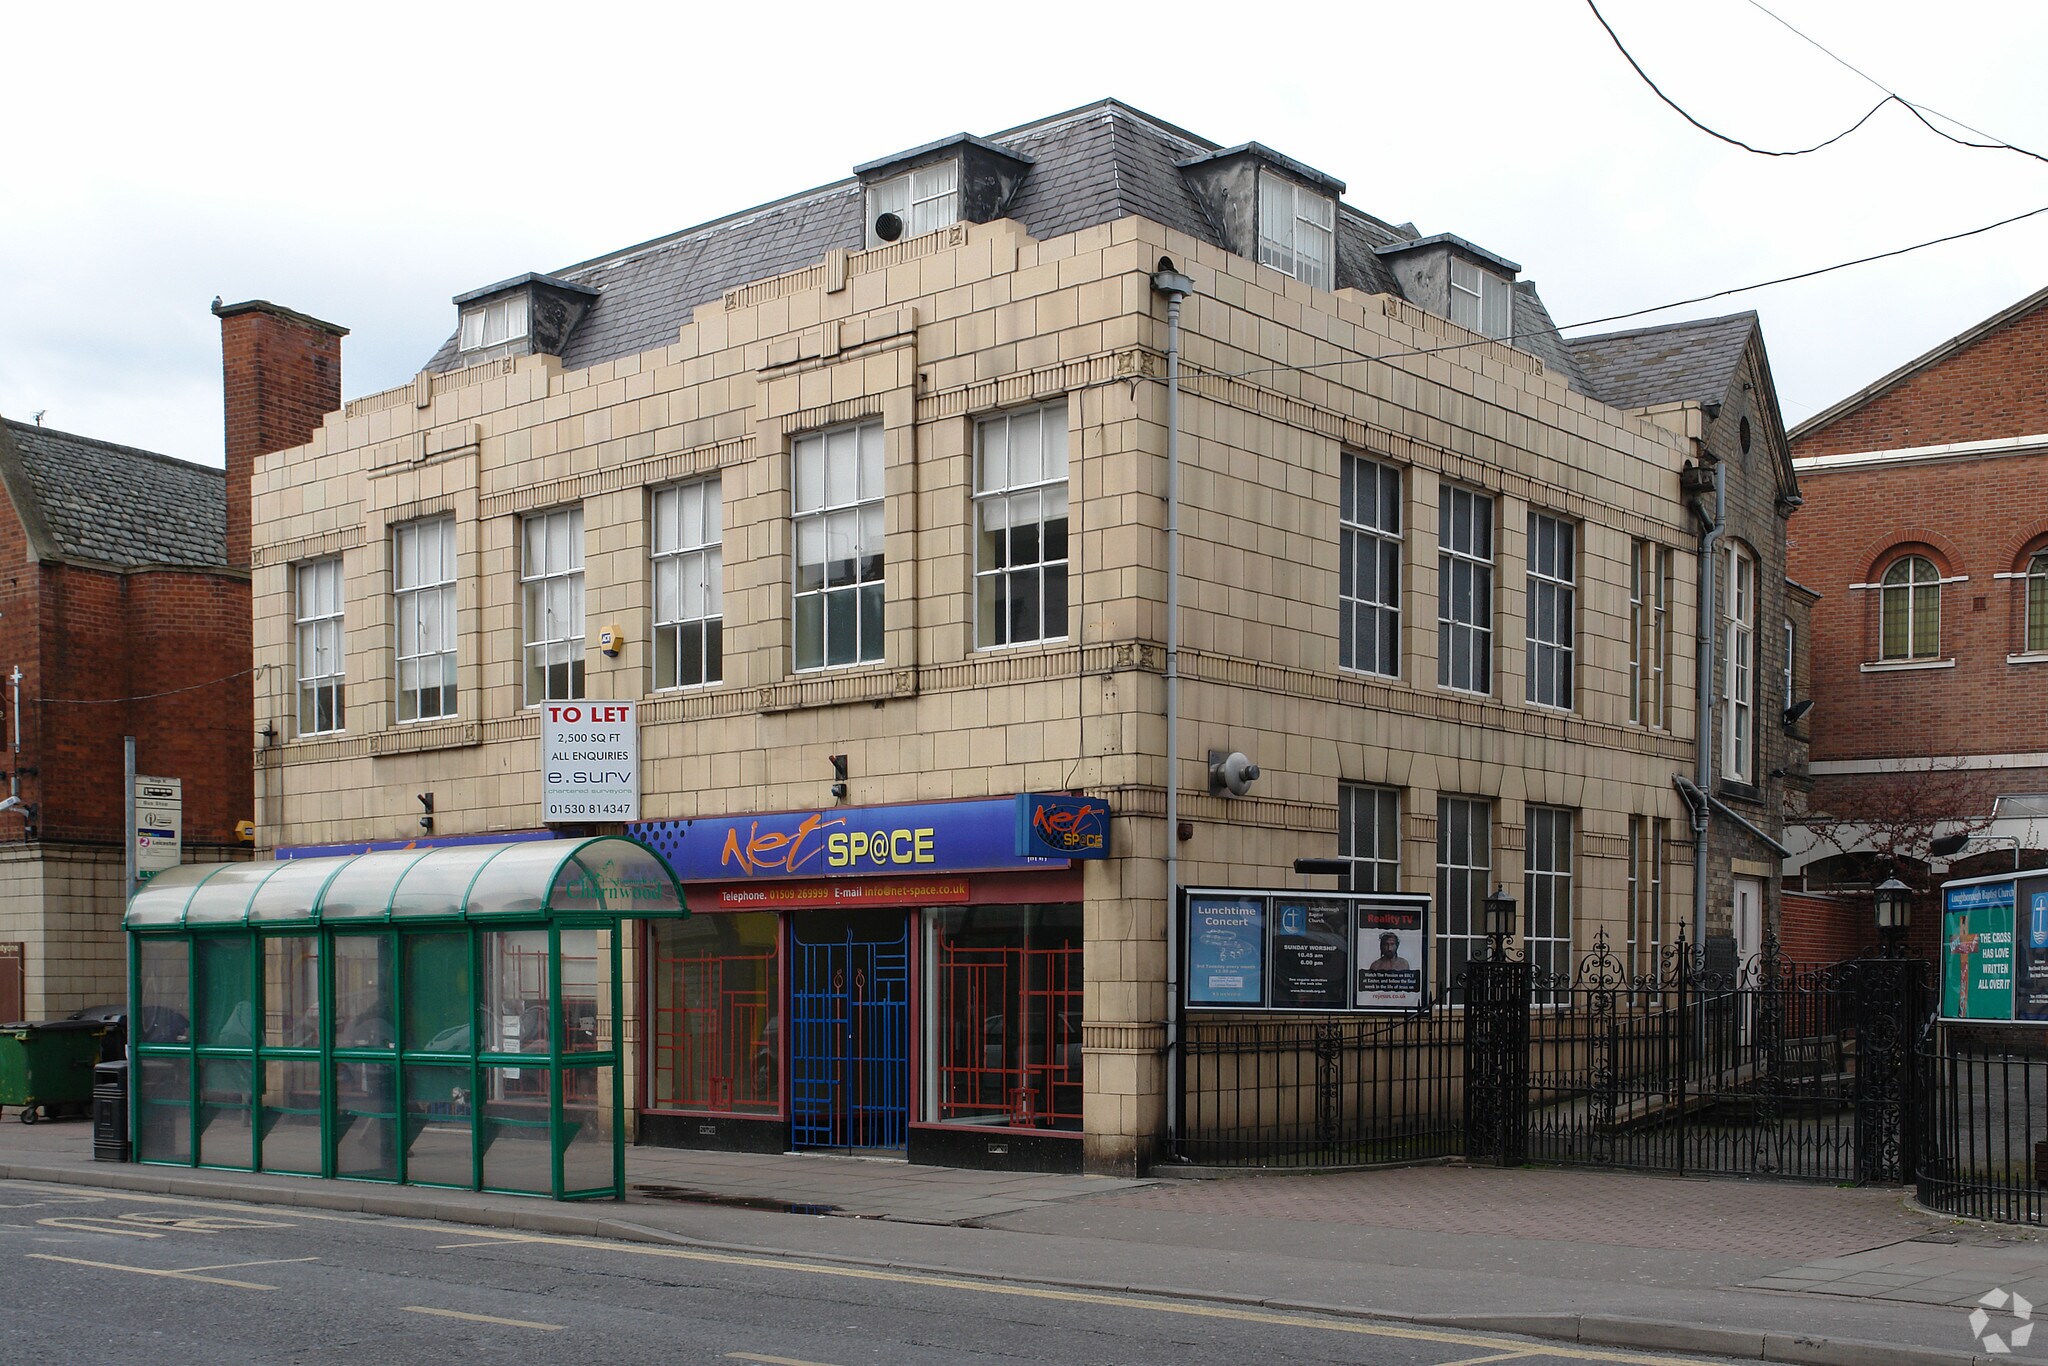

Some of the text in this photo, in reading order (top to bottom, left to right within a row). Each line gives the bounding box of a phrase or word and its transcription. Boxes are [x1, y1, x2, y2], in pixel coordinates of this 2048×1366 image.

[548, 707, 629, 723] TO LET
[558, 733, 621, 744] 2,500 SQ FT
[551, 751, 629, 762] ALL ENQUIRIES
[548, 770, 632, 784] e.surv
[550, 804, 630, 814] 01530 814347
[1033, 803, 1105, 835] Net
[141, 838, 149, 846] 2
[721, 813, 935, 877] Net SP@CE
[1063, 833, 1103, 849] SP@CE
[566, 878, 662, 900] Charnwood
[722, 883, 965, 902] Telephone. 01509 269999 E-mail info@net-space.co.uk
[1951, 890, 1982, 905] Loughborough
[1982, 889, 1997, 902] Baptist
[1198, 906, 1256, 916] Lunchtime
[1205, 917, 1248, 926] Concert
[1367, 913, 1413, 926] Reality TV
[1979, 932, 2012, 943] THE CROSS
[1982, 948, 2010, 959] HAS LOVE
[1983, 963, 2009, 974] WRITTEN
[1978, 979, 2011, 990] ALL OVER IT
